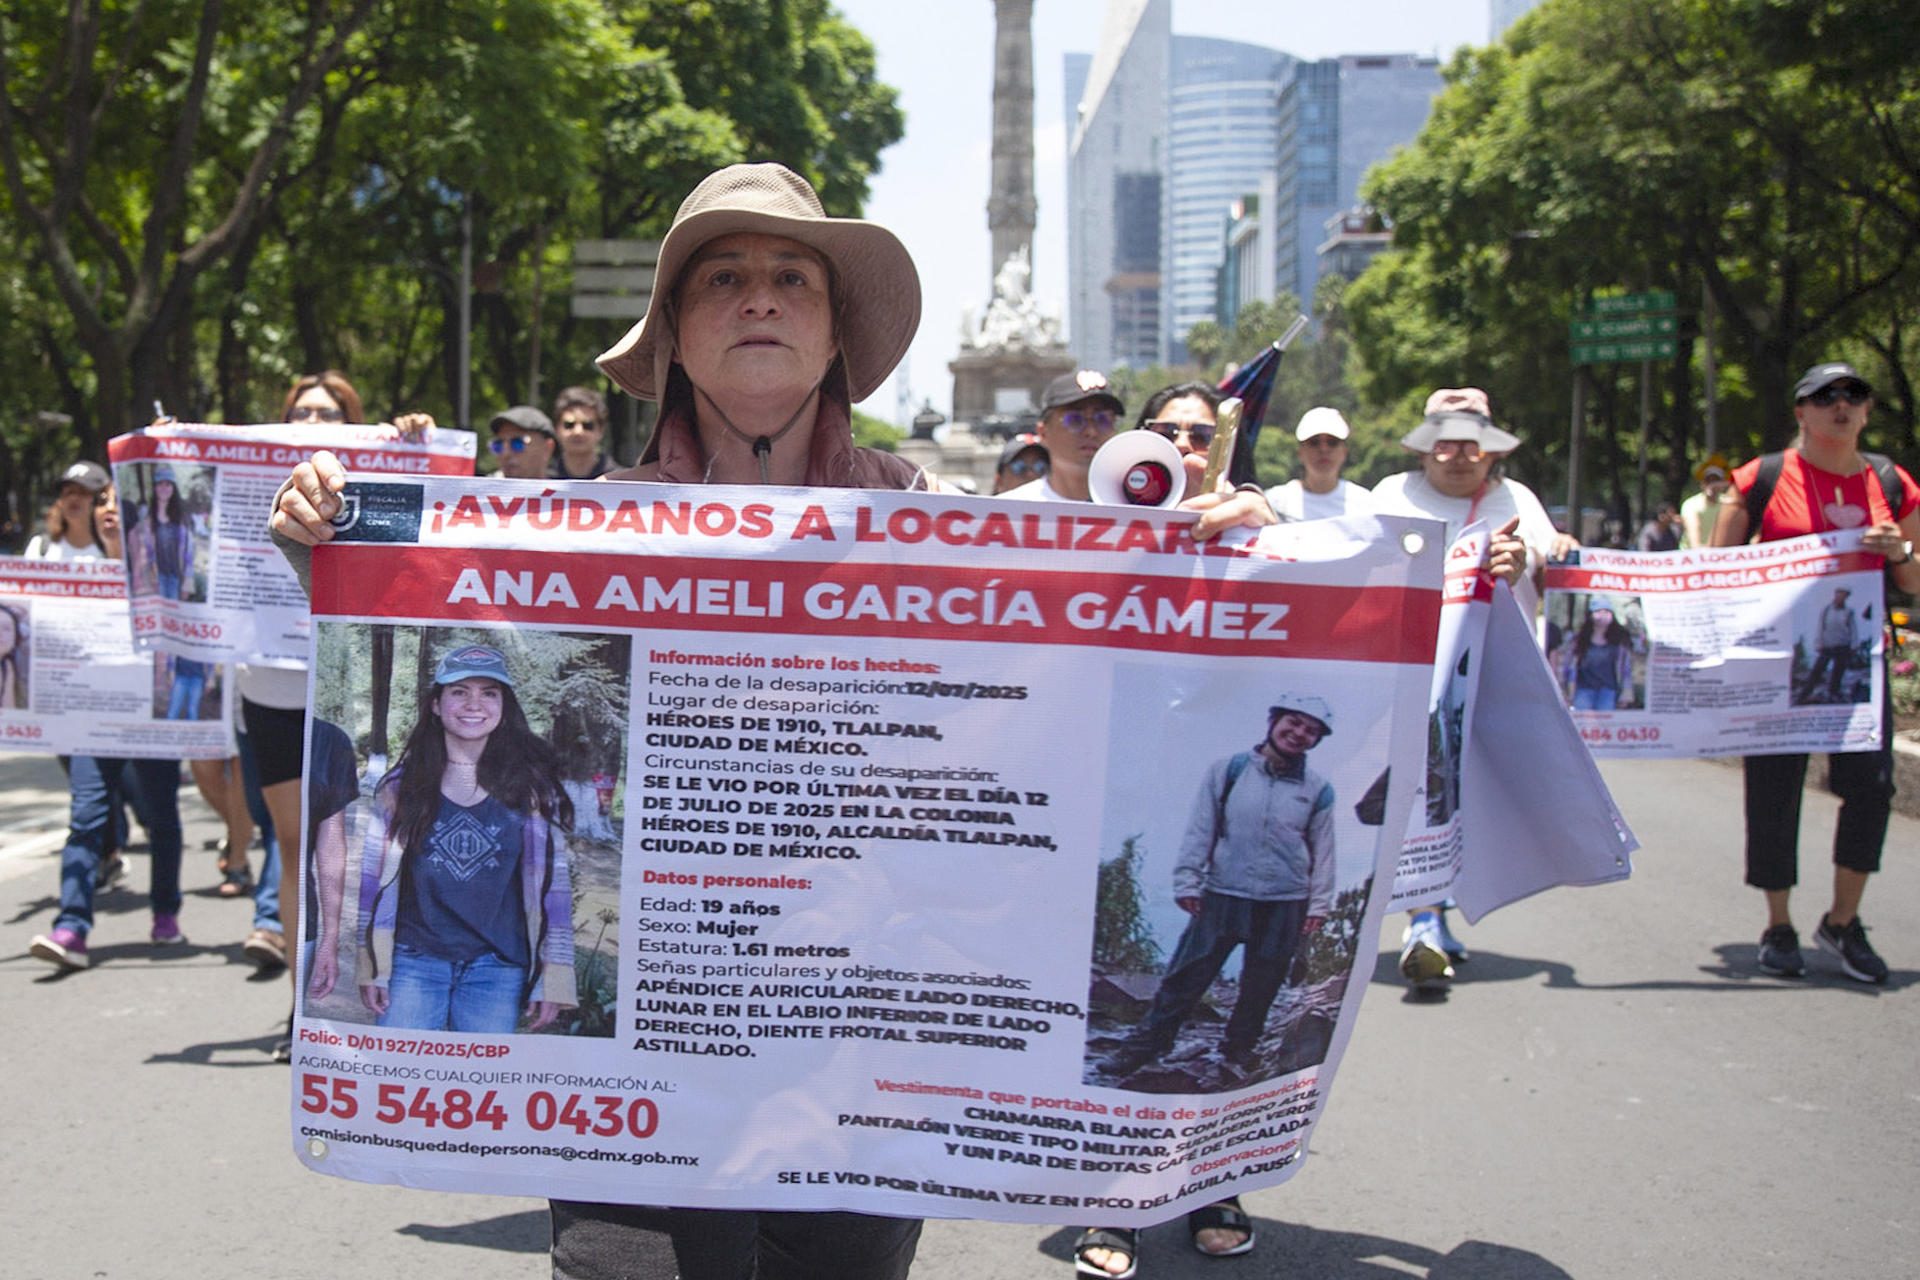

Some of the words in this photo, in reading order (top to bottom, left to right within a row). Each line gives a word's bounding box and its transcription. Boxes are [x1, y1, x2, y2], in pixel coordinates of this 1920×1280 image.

[155, 441, 200, 458] ANA
[205, 445, 267, 462] AMELI
[272, 449, 350, 470] GARA
[356, 452, 431, 473] GÁMEZ
[431, 489, 774, 540] ¡AYÚDANOS
[792, 505, 837, 542] A
[447, 569, 579, 610] ANA
[595, 576, 782, 618] AMELI
[804, 579, 1045, 629] GARCÍA
[1067, 586, 1290, 641] GÁMEZ
[650, 650, 765, 668] Información
[771, 655, 825, 671] sobre
[831, 656, 860, 671] los
[649, 671, 708, 688] Fecha
[715, 674, 741, 689] de
[747, 675, 763, 690] la
[648, 692, 706, 710] Lugar
[712, 695, 738, 709] de
[743, 696, 880, 715] desaparición:
[646, 710, 735, 729] HÉROES
[741, 717, 771, 731] DE
[776, 718, 827, 737] 1910,
[832, 721, 944, 741] TLALPAN,
[645, 733, 732, 750] CIUDAD
[738, 737, 769, 752] DE
[774, 737, 868, 757] MÉXICO.
[644, 754, 794, 774] Circunstancias
[800, 761, 826, 776] de
[831, 766, 855, 777] su
[643, 774, 670, 789] SE
[676, 776, 702, 791] LE
[707, 778, 748, 793] VIO
[753, 780, 800, 796] POR
[806, 779, 890, 798] ÚLTIMA
[895, 786, 941, 801] VEZ
[944, 788, 974, 802] EL
[977, 786, 1021, 805] DÍA
[1023, 791, 1049, 806] 12
[642, 796, 673, 810] DE
[677, 798, 742, 813] JULIO
[747, 801, 778, 816] DE
[783, 802, 835, 818] 2025
[840, 805, 869, 818] EN
[874, 805, 905, 820] LA
[909, 807, 1016, 826] COLONIA
[640, 838, 727, 855] CIUDAD
[733, 843, 763, 857] DE
[768, 841, 862, 860] MÉXICO.
[641, 814, 730, 834] HÉROES
[735, 821, 765, 836] DE
[771, 822, 821, 840] 1910,
[826, 824, 941, 842] ALCALDÍA
[943, 829, 1058, 852] TLALPAN,
[643, 870, 697, 885] Datos
[703, 874, 812, 890] personales:
[640, 897, 696, 913] Edad:
[701, 899, 724, 914] 19
[729, 900, 781, 917] años
[638, 917, 691, 934] Sexo:
[696, 920, 759, 938] Mujer
[638, 938, 728, 956] Estatura:
[732, 942, 768, 957] 1.61
[773, 944, 849, 959] metros
[636, 958, 697, 976] Señas
[702, 962, 821, 979] particulares
[824, 967, 838, 981] y
[842, 965, 920, 983] objetos
[635, 978, 744, 998] APÉNDICE
[904, 990, 968, 1006] LADO
[970, 993, 1086, 1020] DERECHO,
[635, 998, 708, 1016] LUNAR
[713, 1003, 741, 1018] EN
[747, 1004, 772, 1018] EL
[777, 1005, 842, 1020] LABIO
[846, 1005, 949, 1025] INFERIOR
[952, 1012, 984, 1027] DE
[987, 1015, 1051, 1034] LADO
[299, 1028, 342, 1046] Folio:
[347, 1034, 511, 1059] D/01927/2025/CBP
[633, 1038, 756, 1058] ASTILLADO.
[634, 1018, 742, 1040] DERECHO,
[748, 1024, 824, 1039] DIENTE
[829, 1025, 913, 1042] FROTAL
[915, 1030, 1028, 1052] SUPERIOR
[298, 1056, 421, 1080] AGRADECEMOS
[424, 1069, 522, 1085] CUALQUIER
[526, 1072, 648, 1092] INFORMACIÓN
[300, 1073, 359, 1120] 55
[375, 1083, 508, 1131] 5484
[526, 1090, 659, 1139] 0430
[874, 1078, 984, 1100] Vestimenta
[988, 1090, 1026, 1105] que
[1031, 1095, 1107, 1115] portaba
[1113, 1103, 1130, 1118] el
[1136, 1106, 1166, 1120] día
[1172, 1107, 1196, 1120] de
[1200, 1106, 1220, 1119] su
[838, 1114, 950, 1135] PANTALÓN
[953, 1123, 1024, 1145] VERDE
[1028, 1133, 1078, 1151] TIPO
[1081, 1140, 1171, 1158] MILITAR,
[1174, 1116, 1260, 1153] SUDADERA
[1265, 1100, 1318, 1121] VERDE
[964, 1107, 1087, 1133] CHAMARRA
[1090, 1122, 1177, 1140] BLANCA
[1180, 1119, 1219, 1138] CON
[1220, 1101, 1275, 1126] FORRO
[300, 1125, 699, 1167] comisionbusquedadepersonas@cdmx.gob.mx
[944, 1142, 960, 1156] Y
[962, 1144, 995, 1160] UN
[998, 1149, 1042, 1167] PAR
[1046, 1155, 1077, 1171] DE
[1080, 1158, 1153, 1174] BOTAS
[1156, 1149, 1197, 1172] CAFÉ
[1200, 1143, 1223, 1158] DE
[777, 1171, 802, 1184] SE
[806, 1171, 830, 1184] LE
[834, 1172, 871, 1186] VIO
[874, 1175, 919, 1193] POR
[921, 1179, 1000, 1203] ÚLTIMA
[1003, 1191, 1046, 1206] VEZ
[1049, 1195, 1078, 1208] EN
[1083, 1196, 1134, 1209] PICO
[1139, 1193, 1172, 1210] DEL
[1175, 1169, 1238, 1200] ÁGUILA,
[1240, 1151, 1298, 1187] AJUSC
